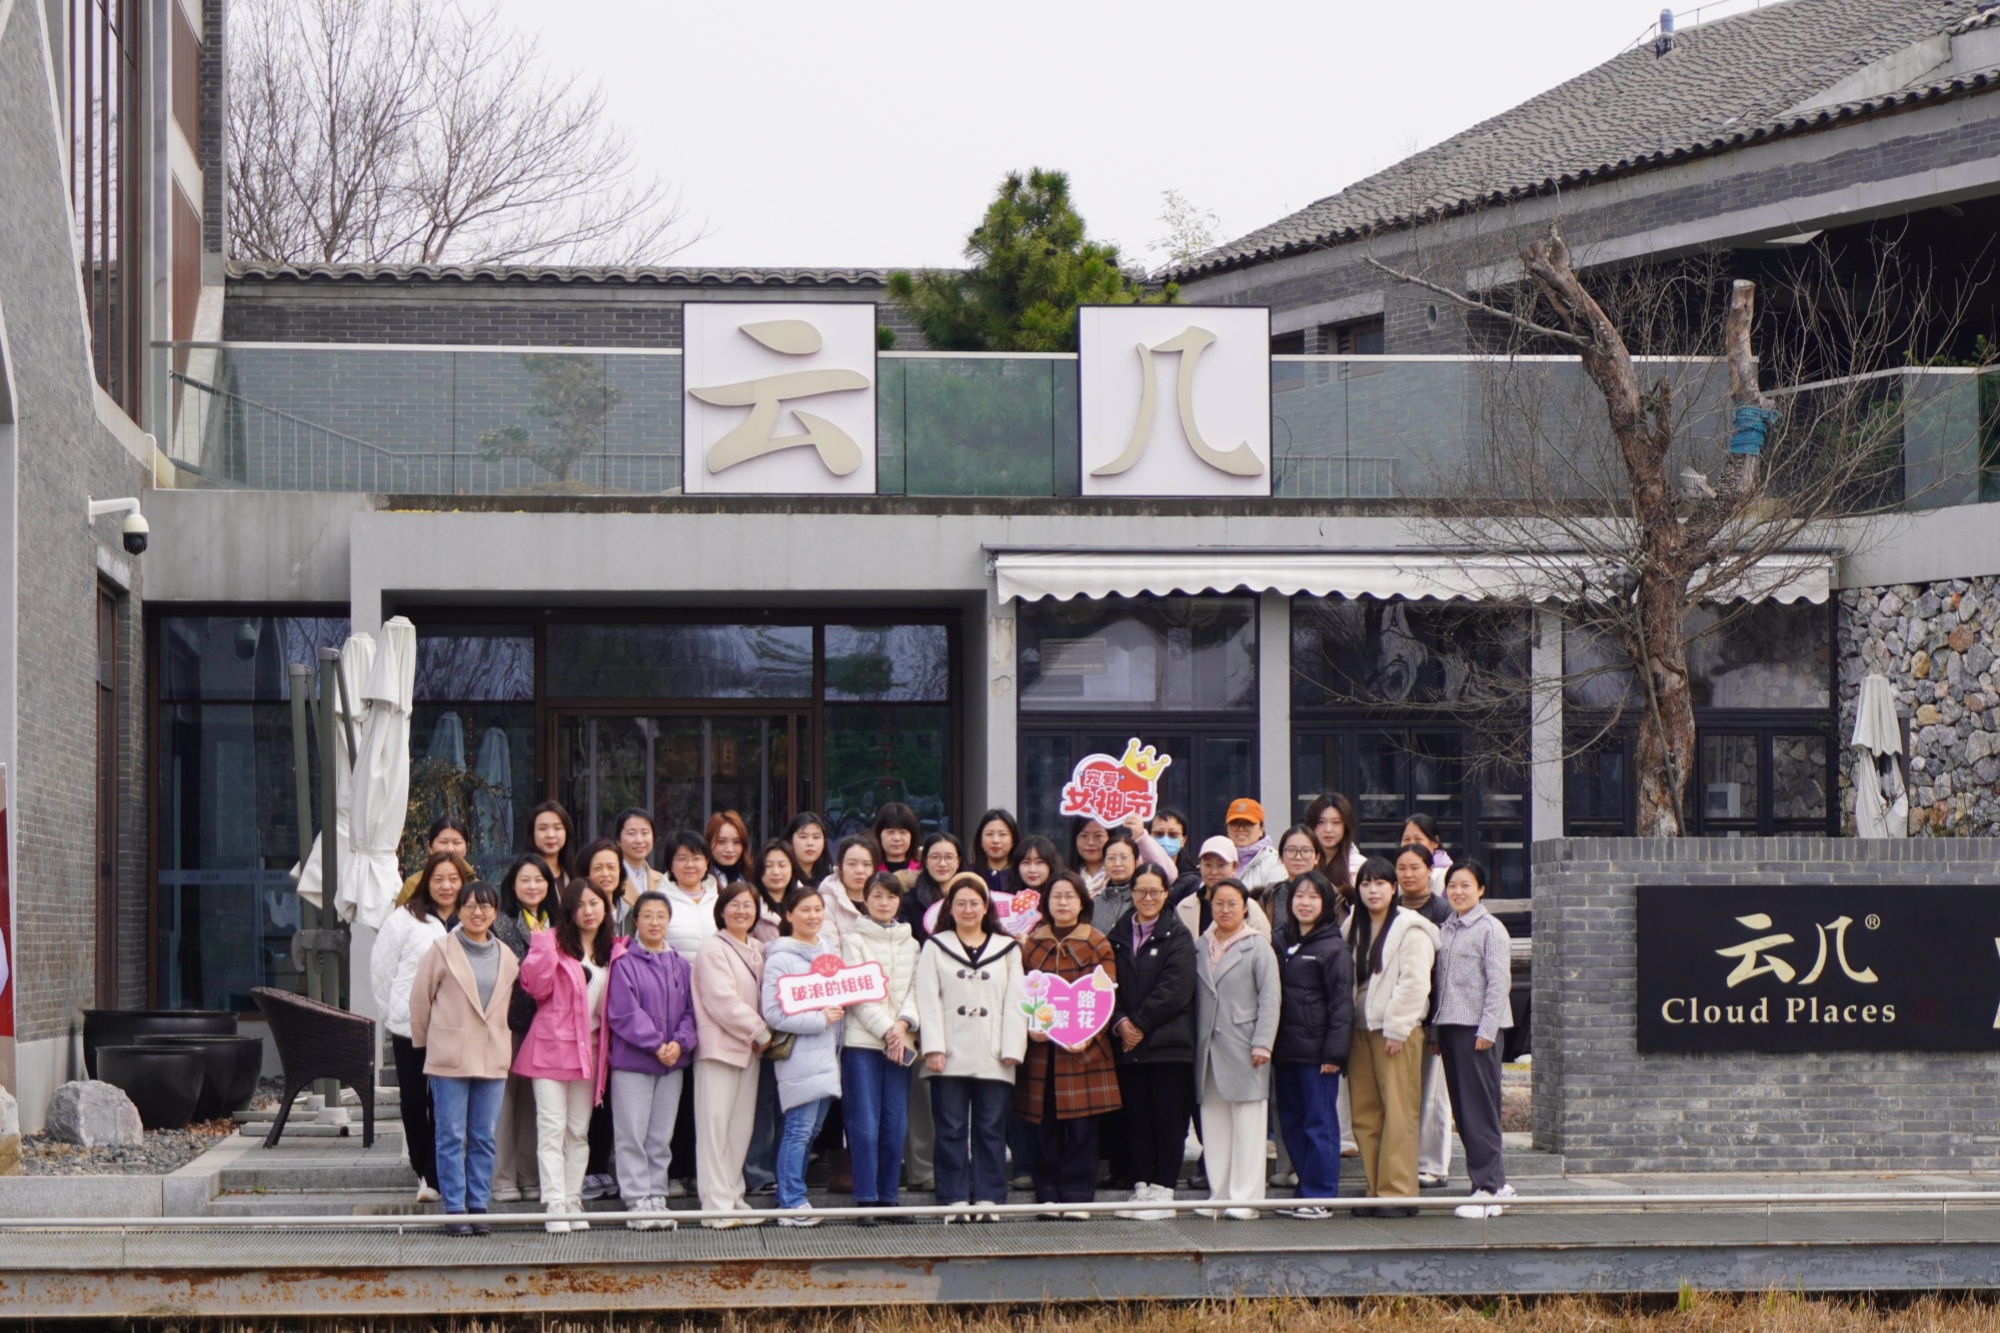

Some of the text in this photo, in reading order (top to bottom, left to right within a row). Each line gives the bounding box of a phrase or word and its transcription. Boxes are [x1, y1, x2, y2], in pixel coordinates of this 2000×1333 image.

[1085, 769, 1119, 788] 宠爱
[1064, 786, 1154, 818] 女神节
[790, 974, 876, 1002] 破浪的姐姐
[1053, 990, 1096, 1009] 一路
[1661, 996, 1770, 1024] Cloud
[1785, 996, 1896, 1024] Places
